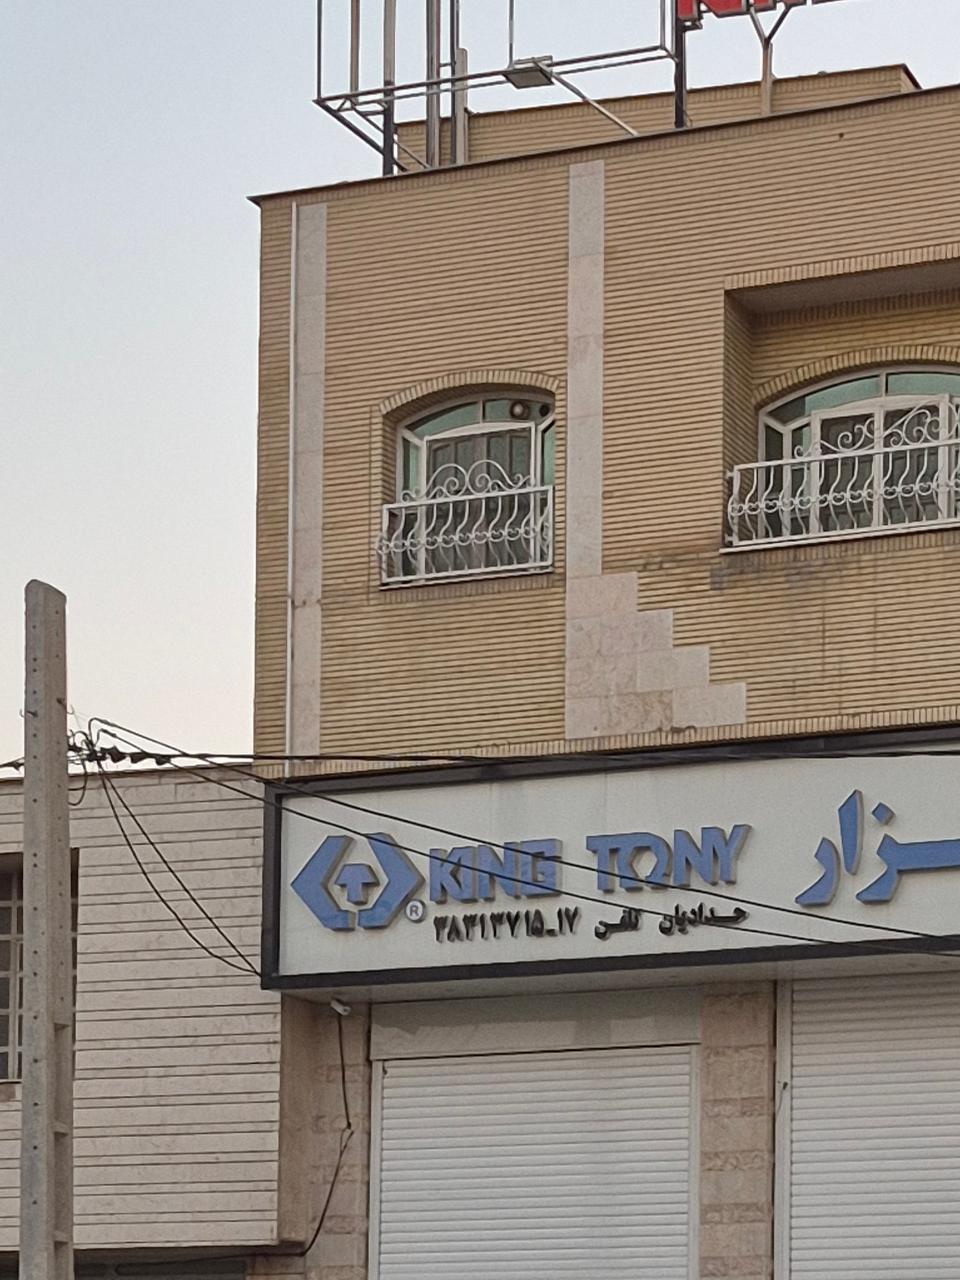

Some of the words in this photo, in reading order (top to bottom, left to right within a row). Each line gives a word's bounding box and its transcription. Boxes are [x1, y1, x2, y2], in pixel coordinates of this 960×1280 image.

[429, 838, 563, 903] KING
[586, 824, 751, 893] TONY
[594, 908, 643, 940] تلفن
